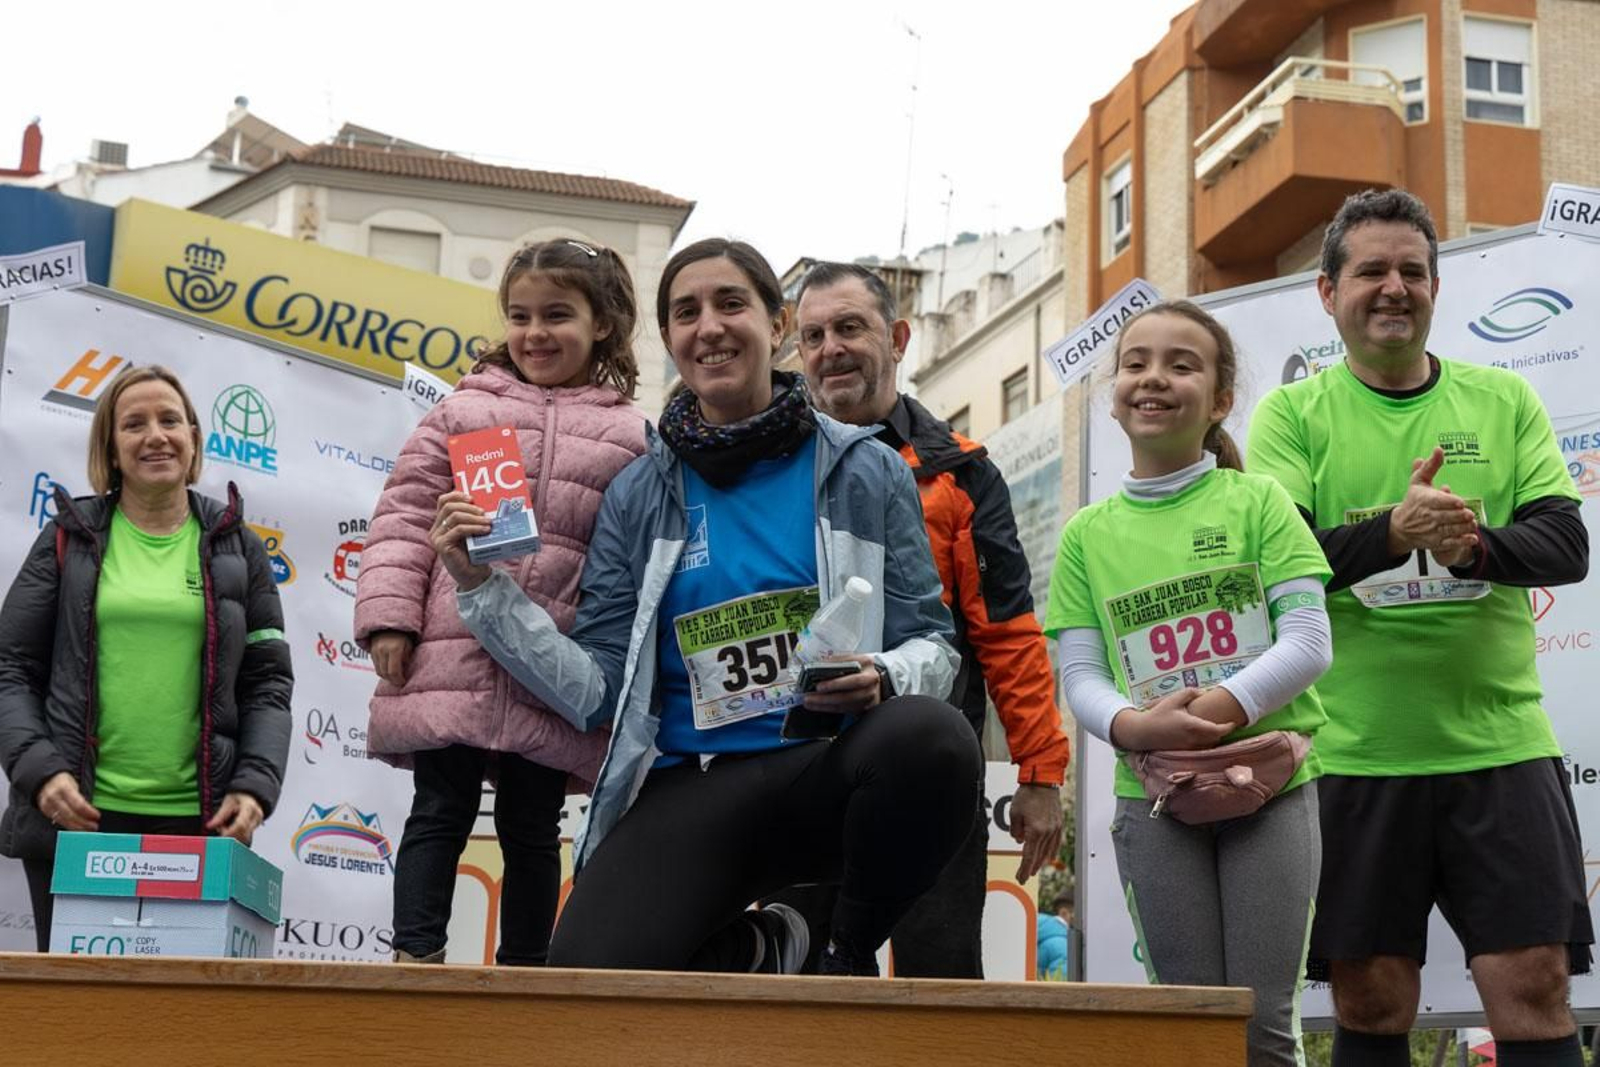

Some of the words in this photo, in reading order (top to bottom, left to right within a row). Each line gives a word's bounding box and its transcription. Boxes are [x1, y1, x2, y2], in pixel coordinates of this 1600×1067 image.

[244, 275, 491, 375] CORREOS
[1511, 350, 1579, 369] Iniciativas
[205, 432, 278, 471] ANPE
[466, 448, 504, 464] Redmi
[1557, 432, 1600, 453] NES
[456, 461, 523, 499] 14C
[1133, 590, 1152, 609] SAN
[1155, 582, 1180, 602] JUAN
[1182, 575, 1213, 594] BOSCO
[702, 610, 722, 628] SAN
[724, 602, 749, 621] JUAN
[751, 596, 780, 615] BOSCO
[1132, 601, 1169, 626] CARRERA
[1169, 591, 1209, 616] POPULAR
[700, 621, 737, 645] CARRERA
[737, 612, 777, 636] POPULAR
[1150, 610, 1238, 671] 928
[1535, 631, 1592, 653] ervic
[91, 856, 126, 874] ECO
[305, 852, 338, 868] JESUS
[341, 857, 386, 875] LORENTE
[135, 946, 160, 955] LASER
[136, 937, 156, 945] COPY
[280, 918, 394, 954] KUO'S
